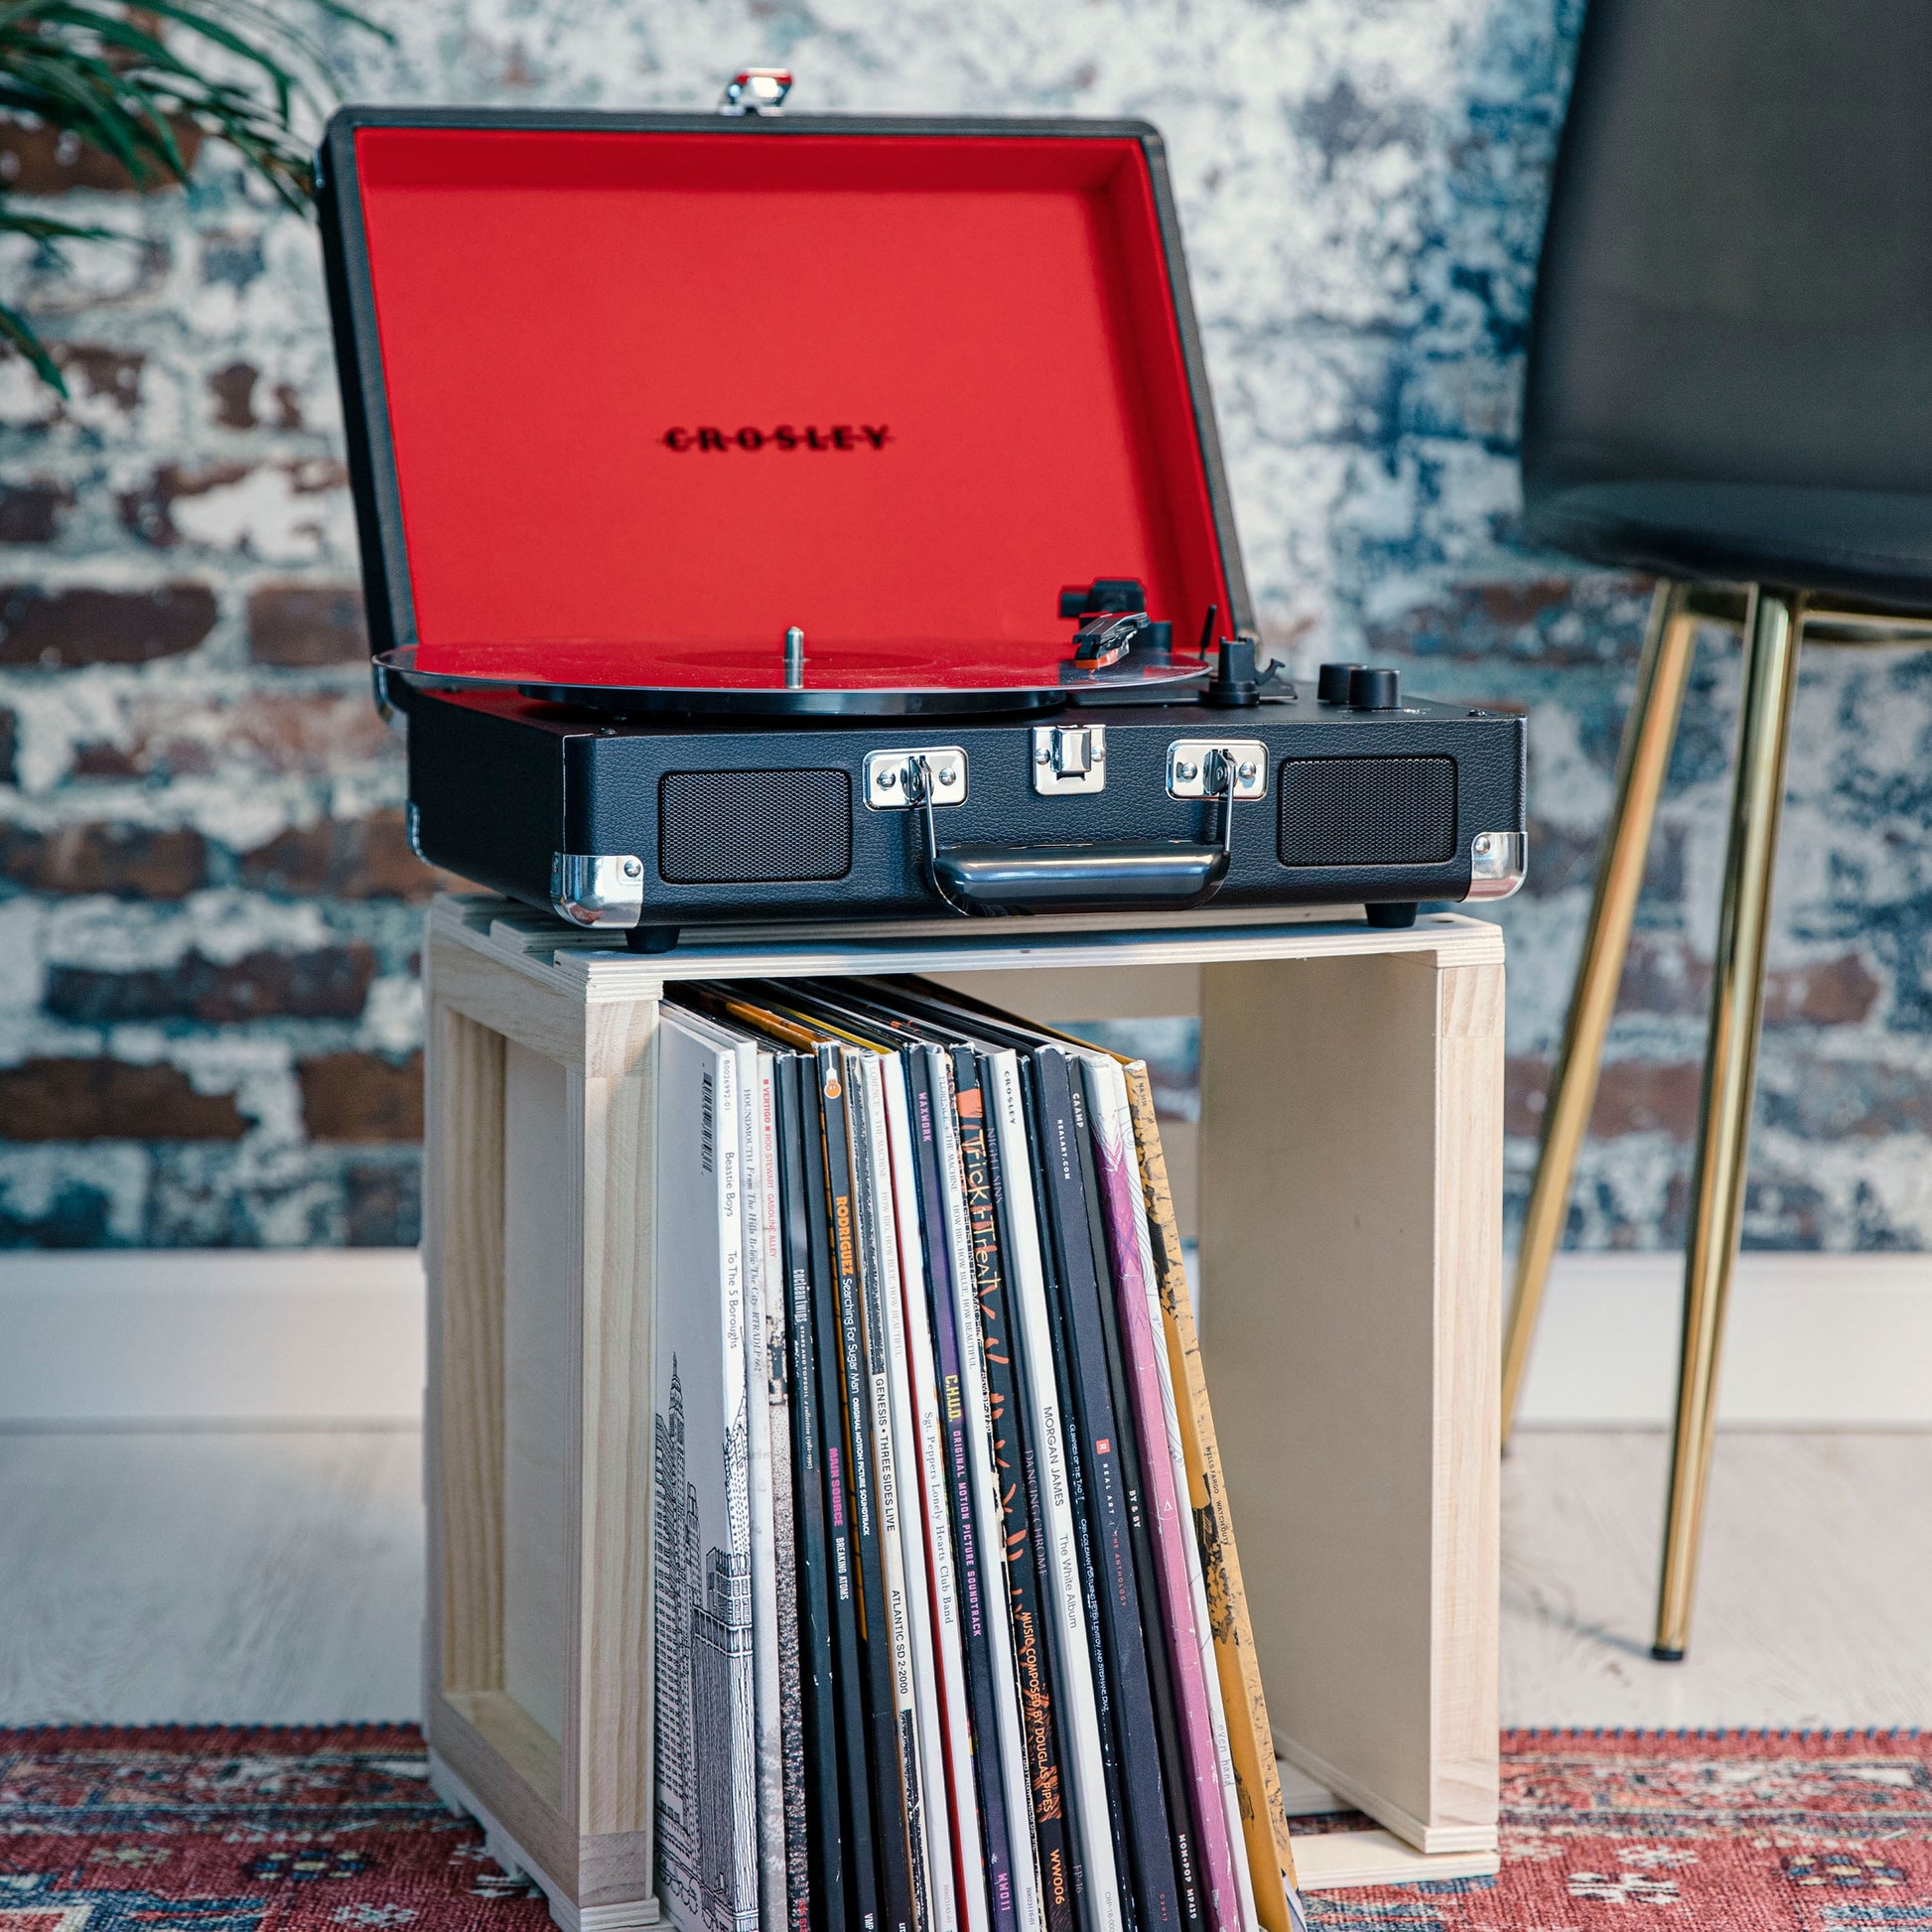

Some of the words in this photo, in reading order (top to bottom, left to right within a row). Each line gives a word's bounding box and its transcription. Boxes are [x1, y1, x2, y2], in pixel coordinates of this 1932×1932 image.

[661, 424, 891, 453] CROSLEY
[938, 1076, 949, 1121] FLORENCE
[1004, 1070, 1016, 1124] CROSLEY
[1072, 1092, 1083, 1128] CAAMP
[743, 1089, 753, 1162] HOUNDMOUTH
[874, 1121, 883, 1136] THE
[918, 1092, 930, 1142] WAXWORK
[876, 1139, 887, 1178] MACHINE
[986, 1127, 999, 1170] NIGHT
[993, 1174, 1003, 1203] SINS
[1056, 1119, 1070, 1179] REALART.COM
[725, 1152, 734, 1188] Beastie
[947, 1153, 958, 1191] MACHINE
[961, 1129, 990, 1204] Trick
[724, 1192, 735, 1216] Boys
[881, 1191, 890, 1212] HOW
[952, 1205, 961, 1226] HOW
[748, 1212, 757, 1234] Hills
[835, 1195, 853, 1275] RODRIGUEZ
[954, 1227, 963, 1246] BIG,
[727, 1251, 736, 1263] To
[749, 1237, 758, 1264] Below
[885, 1235, 894, 1256] HOW
[957, 1248, 966, 1269] HOW
[728, 1266, 737, 1286] The
[792, 1269, 806, 1301] cocteau
[958, 1271, 968, 1296] BLUE,
[750, 1287, 759, 1306] City
[840, 1278, 855, 1324] Searching
[889, 1286, 897, 1308] HOW
[962, 1298, 971, 1319] HOW
[727, 1300, 738, 1348] Boroughs
[752, 1311, 760, 1356] RTRADLP
[846, 1326, 856, 1342] For
[891, 1310, 902, 1357] BEAUTIFUL
[846, 1343, 858, 1369] Sugar
[965, 1321, 976, 1368] BEAUTIFUL
[850, 1372, 860, 1393] Man
[943, 1374, 962, 1422] C.H.U.D.
[852, 1397, 861, 1430] ORIGINAL
[875, 1378, 887, 1426] GENESIS
[922, 1412, 934, 1432] Sgt.
[1042, 1406, 1058, 1463] MORGAN
[828, 1448, 839, 1477] MAIN
[854, 1431, 863, 1460] MOTION
[880, 1436, 890, 1471] THREE
[924, 1436, 938, 1479] Peppers
[951, 1430, 965, 1477] ORIGINAL
[1205, 1446, 1214, 1468] WELLS
[857, 1460, 866, 1487] PICTURE
[883, 1473, 893, 1505] SIDES
[1050, 1467, 1063, 1506] JAMES
[1209, 1469, 1219, 1493] FARGO
[831, 1479, 843, 1526] SOURCE
[859, 1489, 870, 1535] SOUNDTRACK
[929, 1483, 943, 1520] Lonely
[957, 1481, 969, 1519] MOTION
[1025, 1449, 1040, 1515] DANCING
[1033, 1517, 1046, 1576] CHROME
[1128, 1489, 1137, 1502] BY
[1133, 1515, 1141, 1529] BY
[1215, 1499, 1225, 1525] WATCH
[886, 1507, 895, 1531] LIVE
[1102, 1462, 1111, 1489] REAL
[1114, 1553, 1126, 1606] ANTHOLOGY
[835, 1537, 847, 1573] BREAKING
[935, 1525, 947, 1561] Hearts
[961, 1524, 974, 1566] PICTURE
[1058, 1534, 1069, 1556] The
[1082, 1533, 1091, 1565] COLEMAN
[838, 1576, 849, 1599] ATOMS
[939, 1566, 950, 1590] Club
[1061, 1558, 1074, 1590] White
[892, 1589, 903, 1641] ATLANTIC
[942, 1596, 953, 1623] Band
[966, 1570, 981, 1636] SOUNDTRACK
[1065, 1592, 1079, 1628] Album
[1022, 1611, 1034, 1644] MUSIC
[896, 1644, 904, 1658] SD
[897, 1661, 907, 1694] 2-2000
[1026, 1648, 1041, 1707] COMPOSED
[1033, 1711, 1043, 1725] BY
[1035, 1728, 1049, 1779] DOUGLAS
[1040, 1781, 1052, 1812] PIPES
[998, 1872, 1010, 1911] WW011
[1049, 1849, 1064, 1904] WW006
